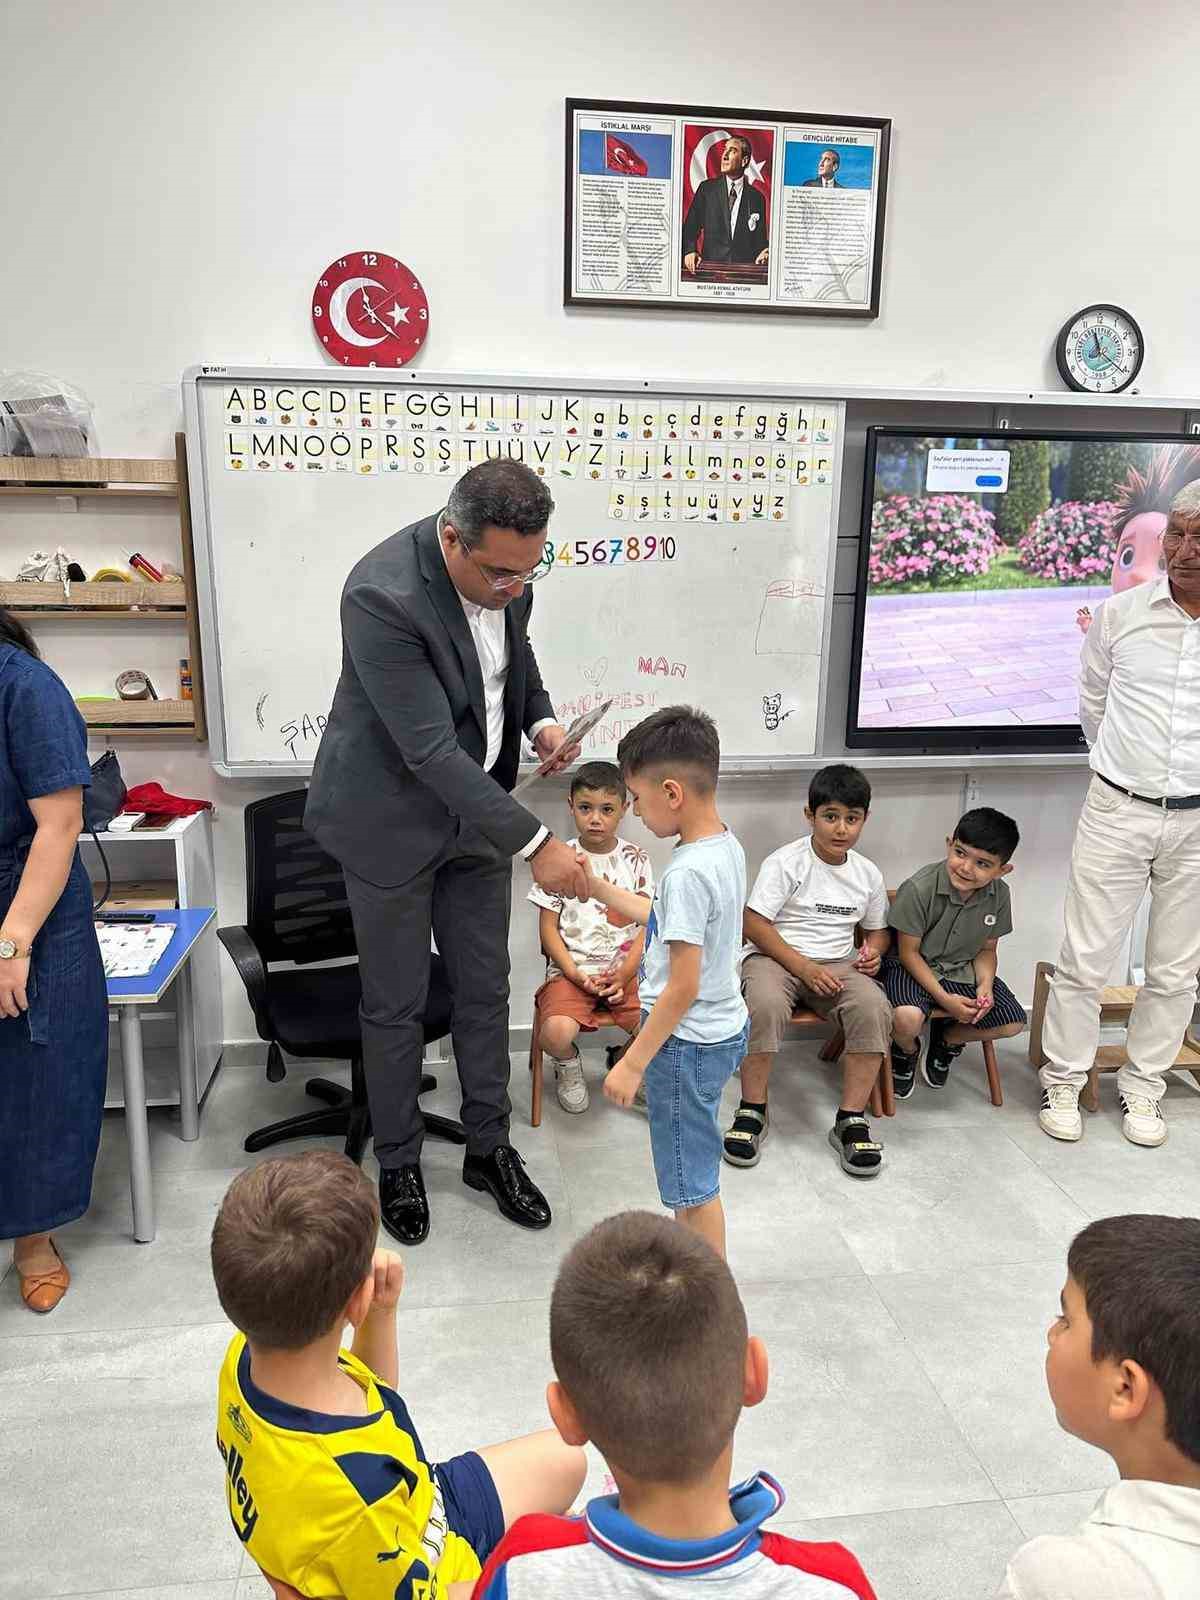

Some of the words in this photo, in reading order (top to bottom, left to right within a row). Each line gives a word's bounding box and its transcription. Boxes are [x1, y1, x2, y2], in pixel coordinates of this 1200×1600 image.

[631, 124, 651, 132] MARŞI
[362, 255, 377, 266] 12
[314, 306, 322, 316] 9
[419, 309, 427, 319] 3
[1072, 331, 1079, 339] 10
[227, 388, 244, 409] A
[254, 389, 267, 410] B
[276, 390, 295, 411] C
[303, 391, 321, 416] Ç
[330, 391, 346, 413] D
[360, 392, 372, 414] E
[385, 393, 397, 414] F
[407, 394, 427, 415] G
[431, 392, 451, 416] Ğ
[462, 396, 478, 417] H
[541, 400, 553, 420] J
[566, 400, 579, 420] K
[594, 413, 604, 423] a
[619, 404, 629, 425] b
[644, 415, 653, 425] c
[667, 414, 677, 429] ç
[691, 405, 700, 425] d
[714, 415, 723, 426] e
[736, 406, 746, 426] f
[756, 415, 766, 434] g
[777, 411, 787, 436] ğ
[798, 408, 807, 429] h
[229, 434, 243, 455] L
[253, 434, 274, 456] M
[280, 435, 298, 456] N
[304, 436, 324, 456] O
[330, 431, 351, 456] Ö
[361, 437, 372, 459] P
[386, 435, 398, 456] R
[413, 437, 425, 458] S
[439, 439, 451, 465] Ş
[463, 440, 477, 461] T
[486, 440, 501, 460] U
[508, 438, 523, 462] Ü
[534, 440, 551, 462] V
[566, 440, 580, 462] Y
[589, 444, 604, 465] Z
[620, 453, 624, 466] i
[641, 451, 649, 475] j
[664, 445, 672, 465] k
[689, 446, 693, 465] l
[708, 457, 722, 467] m
[734, 458, 743, 468] n
[755, 456, 765, 467] o
[776, 454, 786, 468] ö
[797, 460, 807, 479] p
[818, 459, 827, 470] r
[617, 494, 624, 505] s
[641, 496, 648, 511] ş
[664, 491, 672, 507] t
[688, 497, 698, 507] u
[708, 495, 718, 509] ü
[733, 498, 742, 508] v
[753, 495, 763, 513] y
[775, 496, 785, 507] z
[541, 541, 554, 564] 3
[558, 543, 573, 565] 4
[575, 542, 589, 564] 5
[592, 540, 607, 562] 6
[609, 540, 623, 563] 7
[626, 537, 640, 560] 8
[643, 536, 656, 559] 9
[660, 537, 676, 559] 10
[638, 656, 688, 679] MAN
